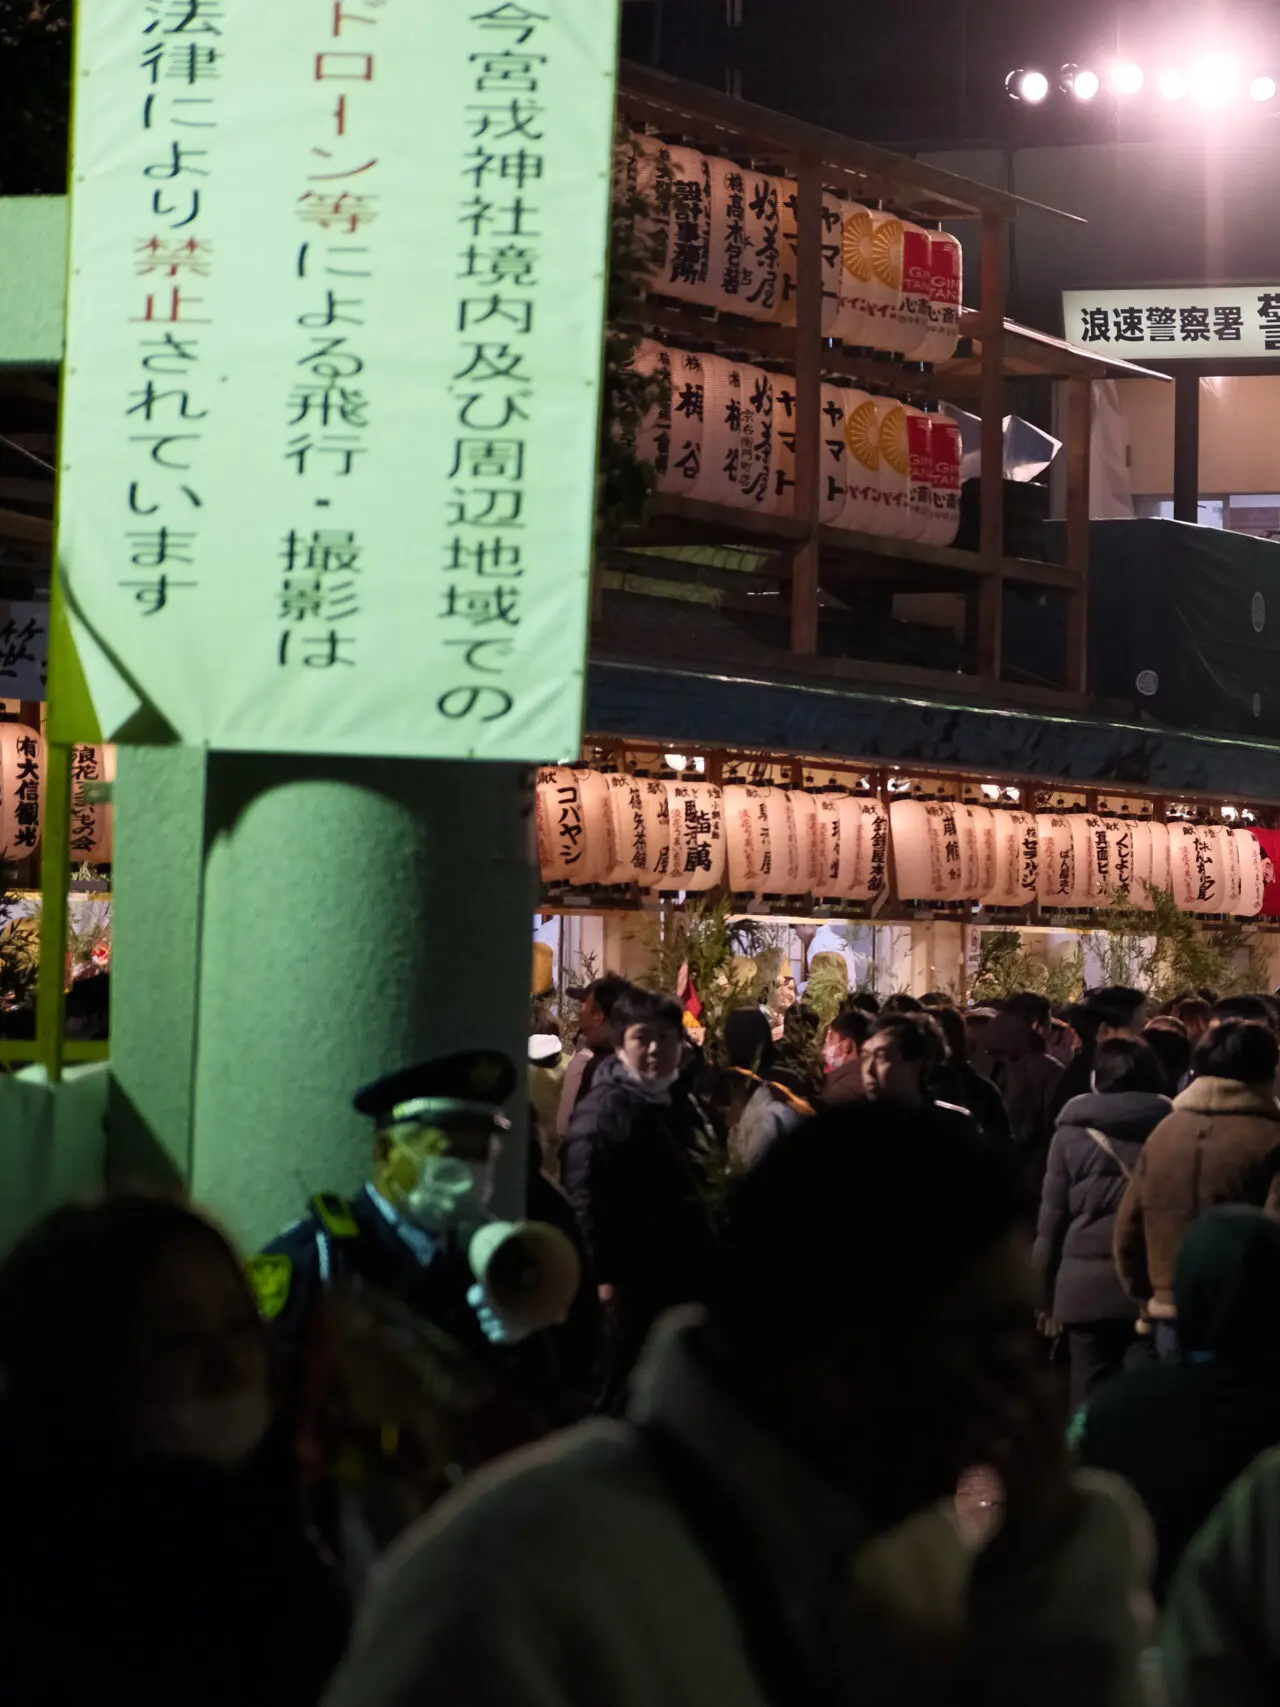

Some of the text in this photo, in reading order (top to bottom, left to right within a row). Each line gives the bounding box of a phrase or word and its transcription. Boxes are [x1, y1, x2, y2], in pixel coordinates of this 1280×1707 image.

[119, 0, 223, 616] 法律により禁止されています
[278, 0, 378, 670] ドローン等による飛行・撮影は
[437, 1, 548, 724] 今宮戎神社境内及び周辺地域での
[822, 399, 846, 502] ヤマト
[1081, 306, 1243, 342] 浪速警察署
